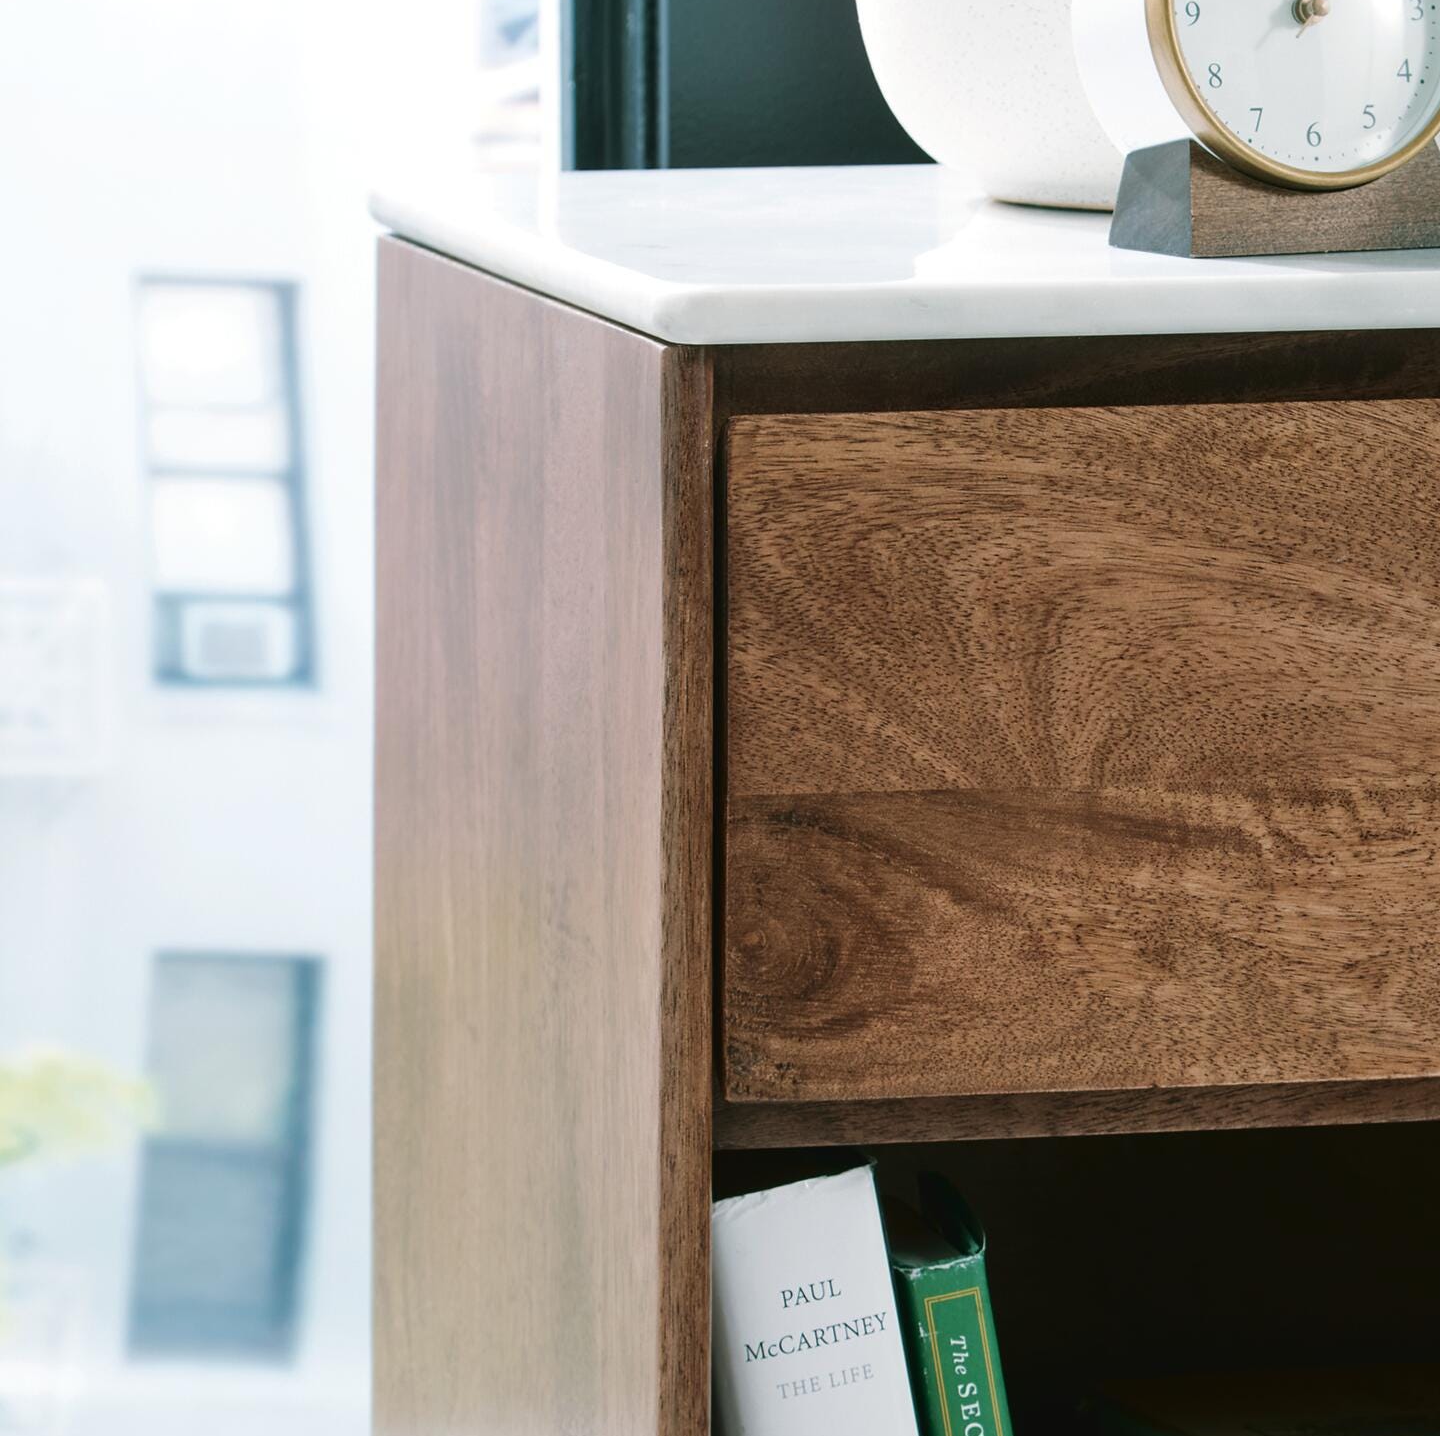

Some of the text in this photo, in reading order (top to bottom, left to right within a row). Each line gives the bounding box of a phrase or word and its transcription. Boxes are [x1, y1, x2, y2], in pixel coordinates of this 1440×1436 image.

[1185, 1, 1201, 26] 9
[1208, 63, 1223, 88] 8
[1397, 58, 1412, 83] 4
[1249, 107, 1264, 132] 7
[1362, 104, 1376, 129] 5
[1306, 121, 1322, 147] 6
[780, 1278, 842, 1308] PAUL
[744, 1311, 888, 1363] McCARTNEY
[950, 1335, 969, 1375] The
[776, 1363, 875, 1400] THE LIFE
